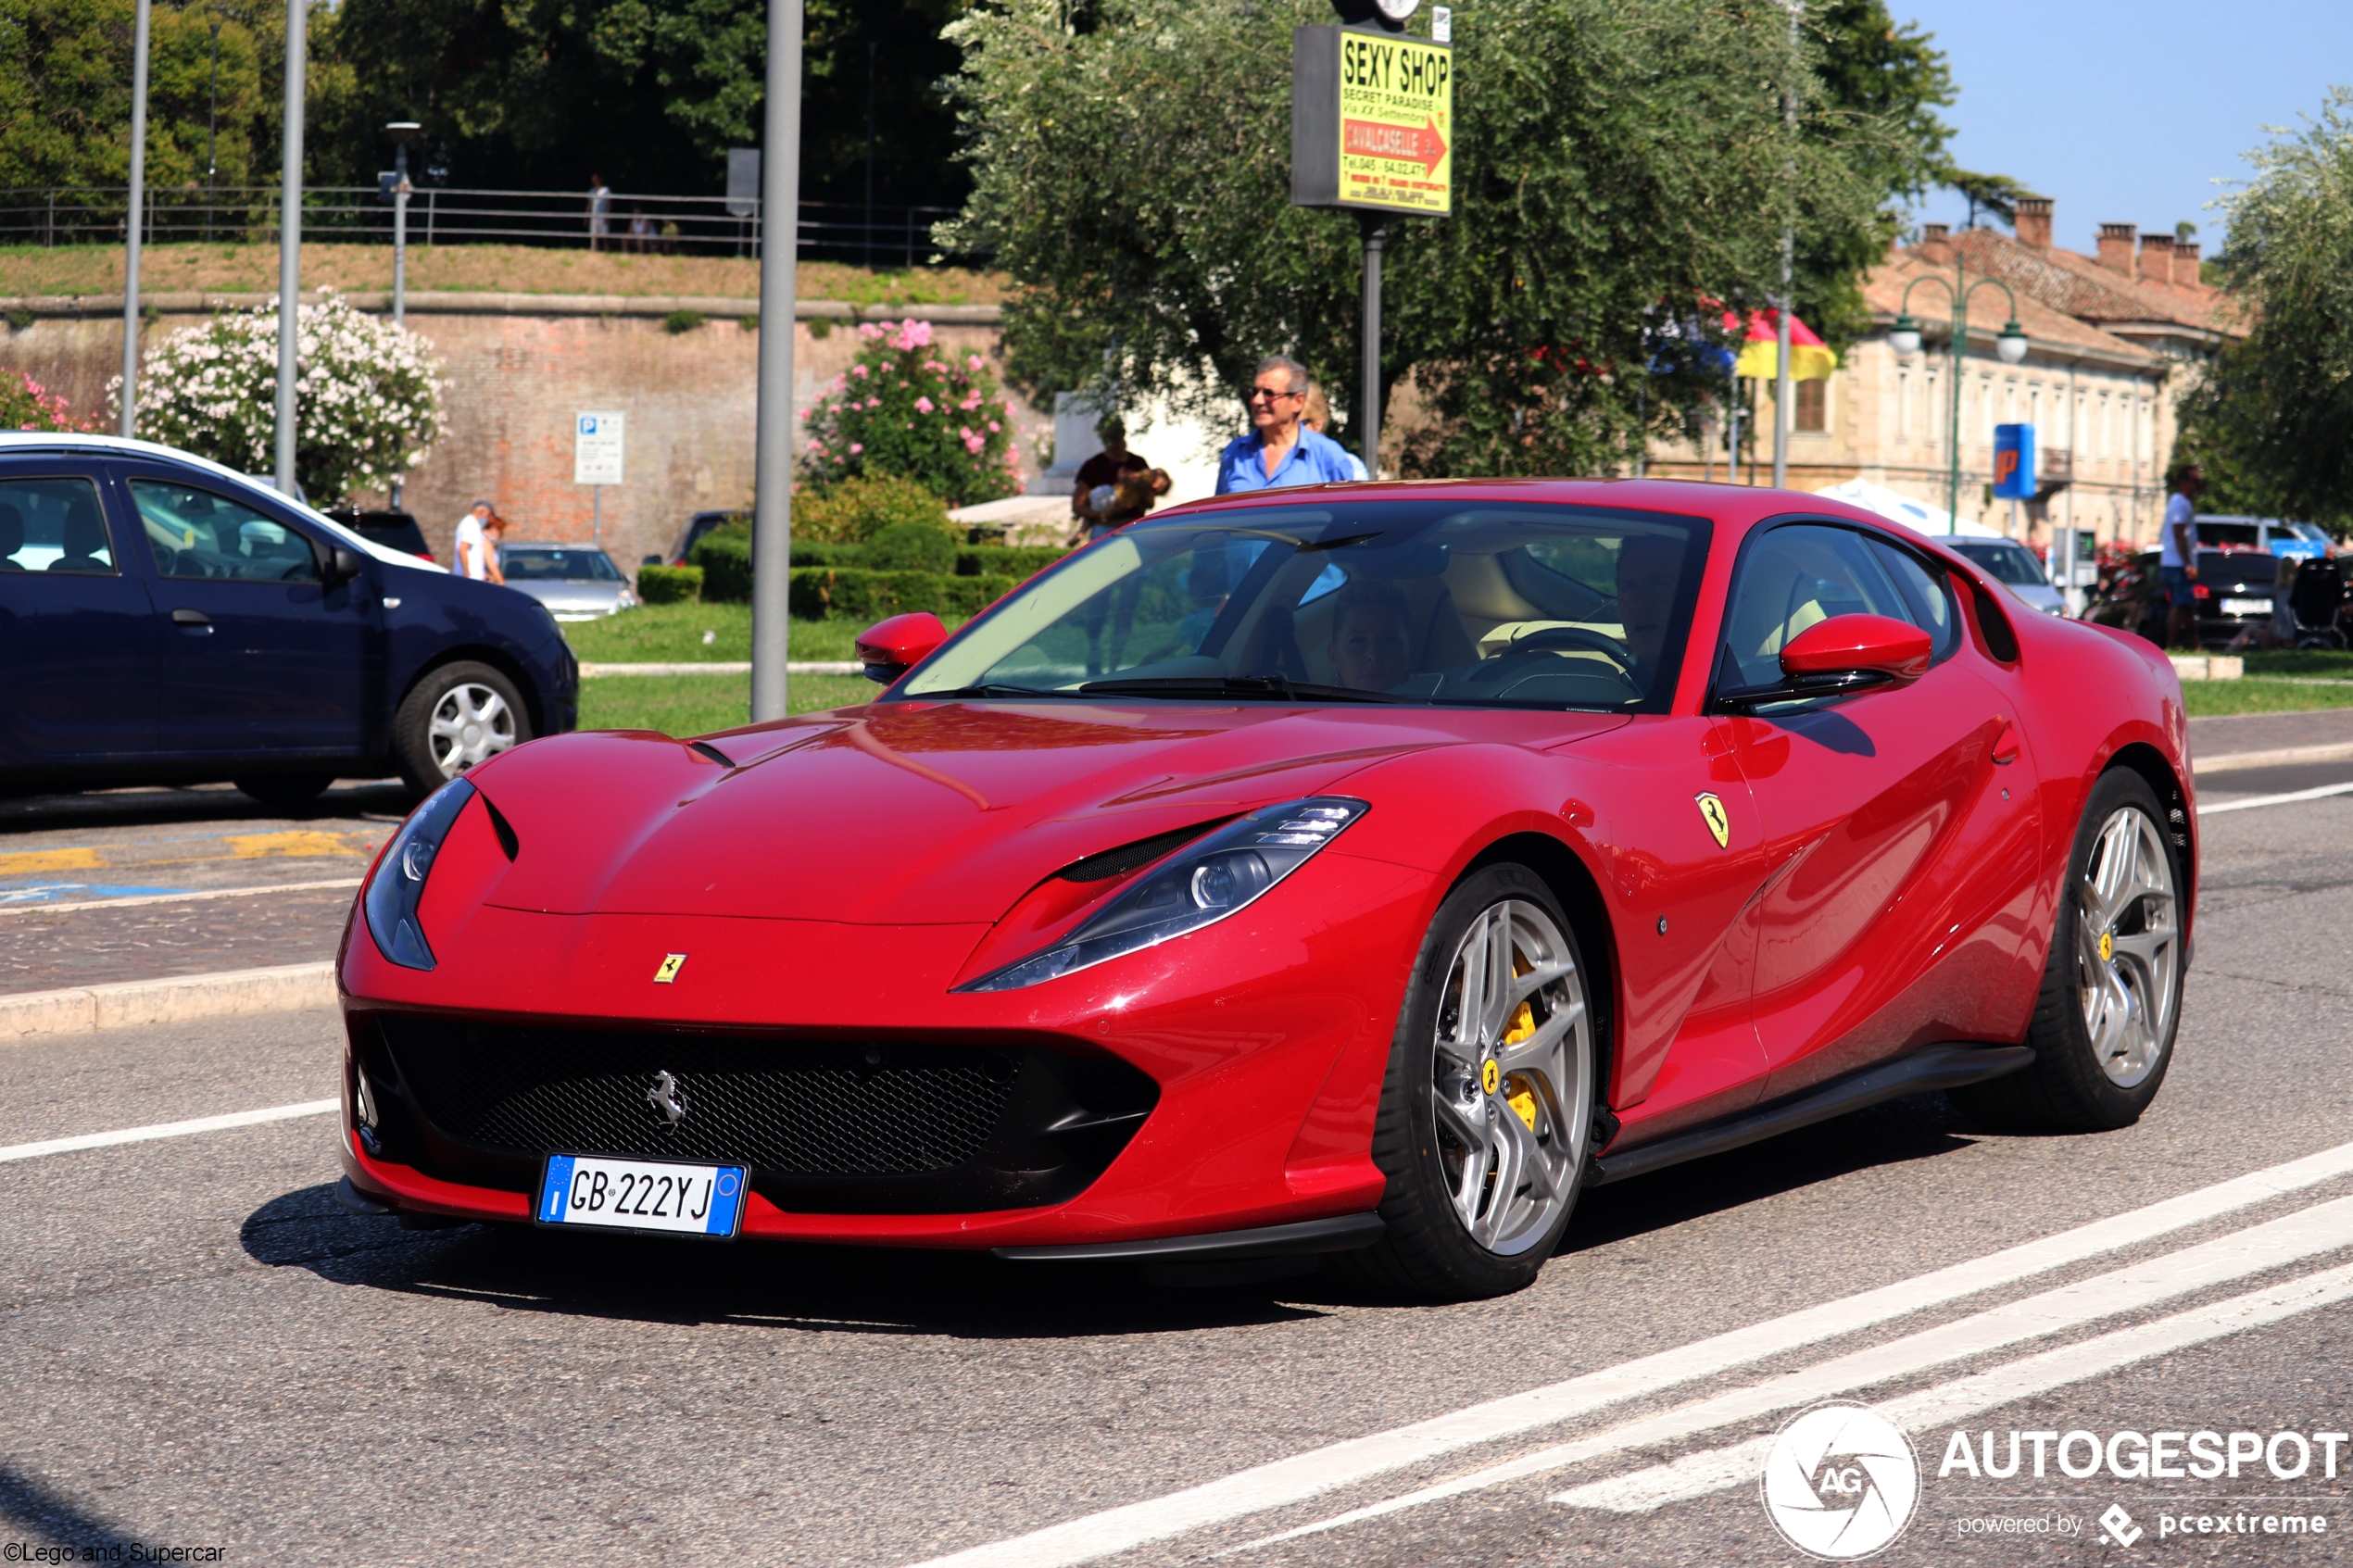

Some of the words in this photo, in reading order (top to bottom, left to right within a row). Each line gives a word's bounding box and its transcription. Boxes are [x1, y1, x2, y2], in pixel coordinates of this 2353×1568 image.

[1344, 40, 1393, 89] SEXY
[1400, 48, 1448, 97] SHOP
[1343, 87, 1381, 103] SECRET
[1386, 94, 1433, 111] PARADISE
[1343, 102, 1357, 114] Via
[1378, 107, 1426, 123] Settembre
[583, 419, 595, 433] P
